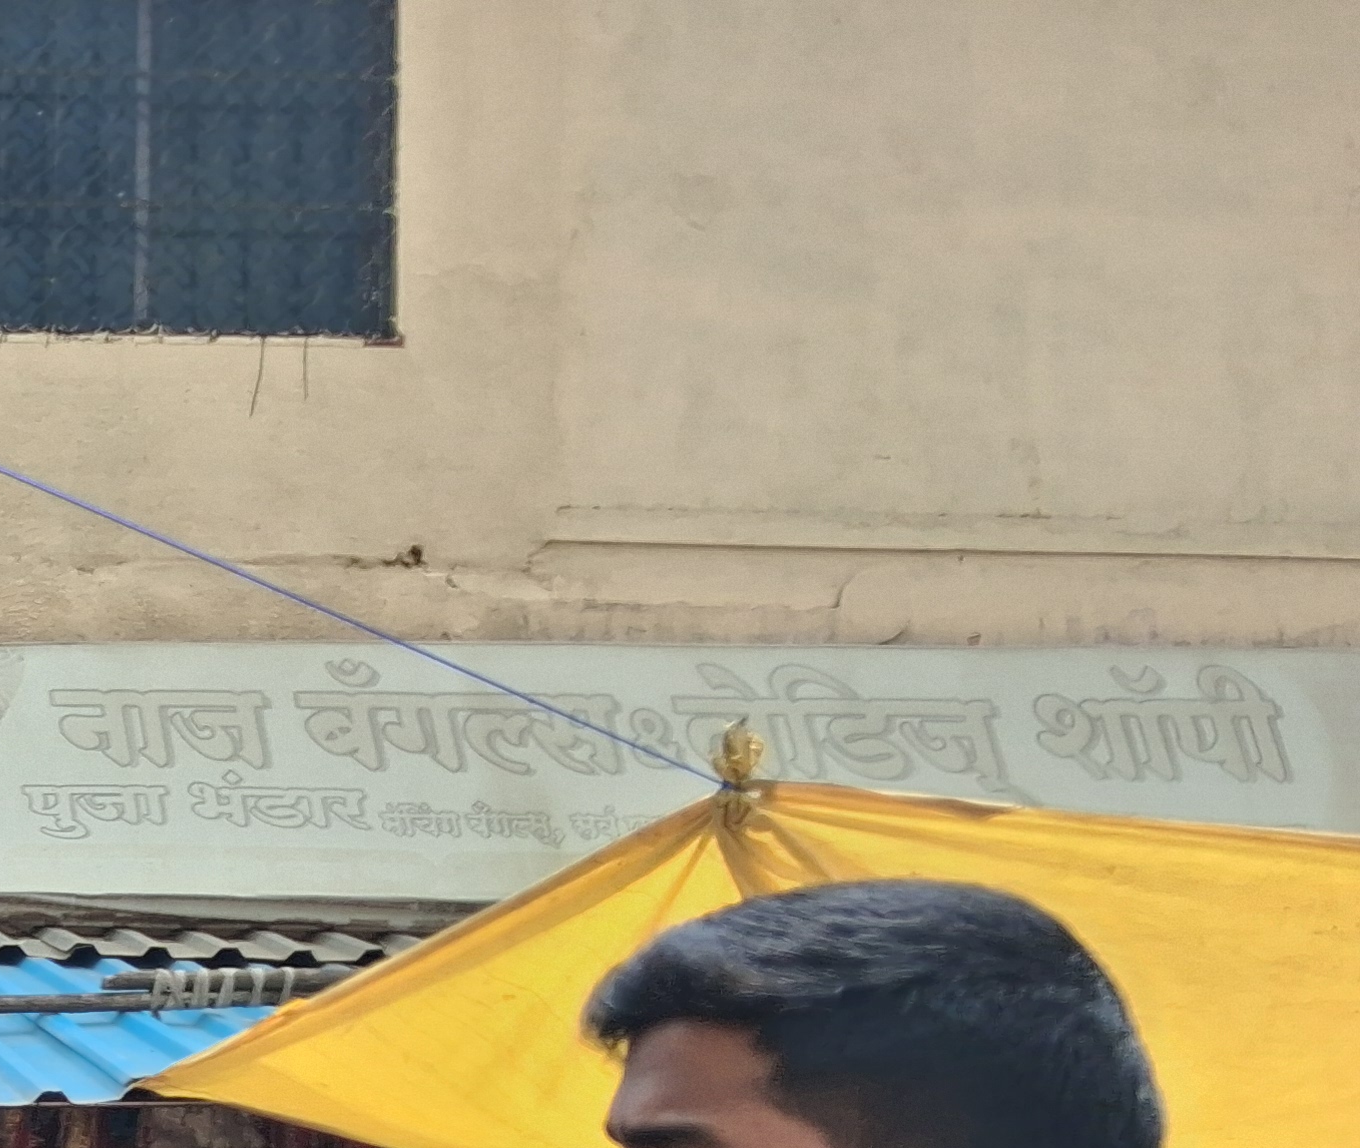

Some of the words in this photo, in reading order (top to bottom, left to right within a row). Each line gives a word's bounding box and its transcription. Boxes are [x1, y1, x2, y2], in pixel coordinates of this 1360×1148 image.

[50, 688, 272, 771] नाज
[630, 707, 688, 770] &
[1033, 664, 1295, 784] शॉपी
[21, 784, 170, 840] पुजा
[188, 769, 372, 830] भंडार
